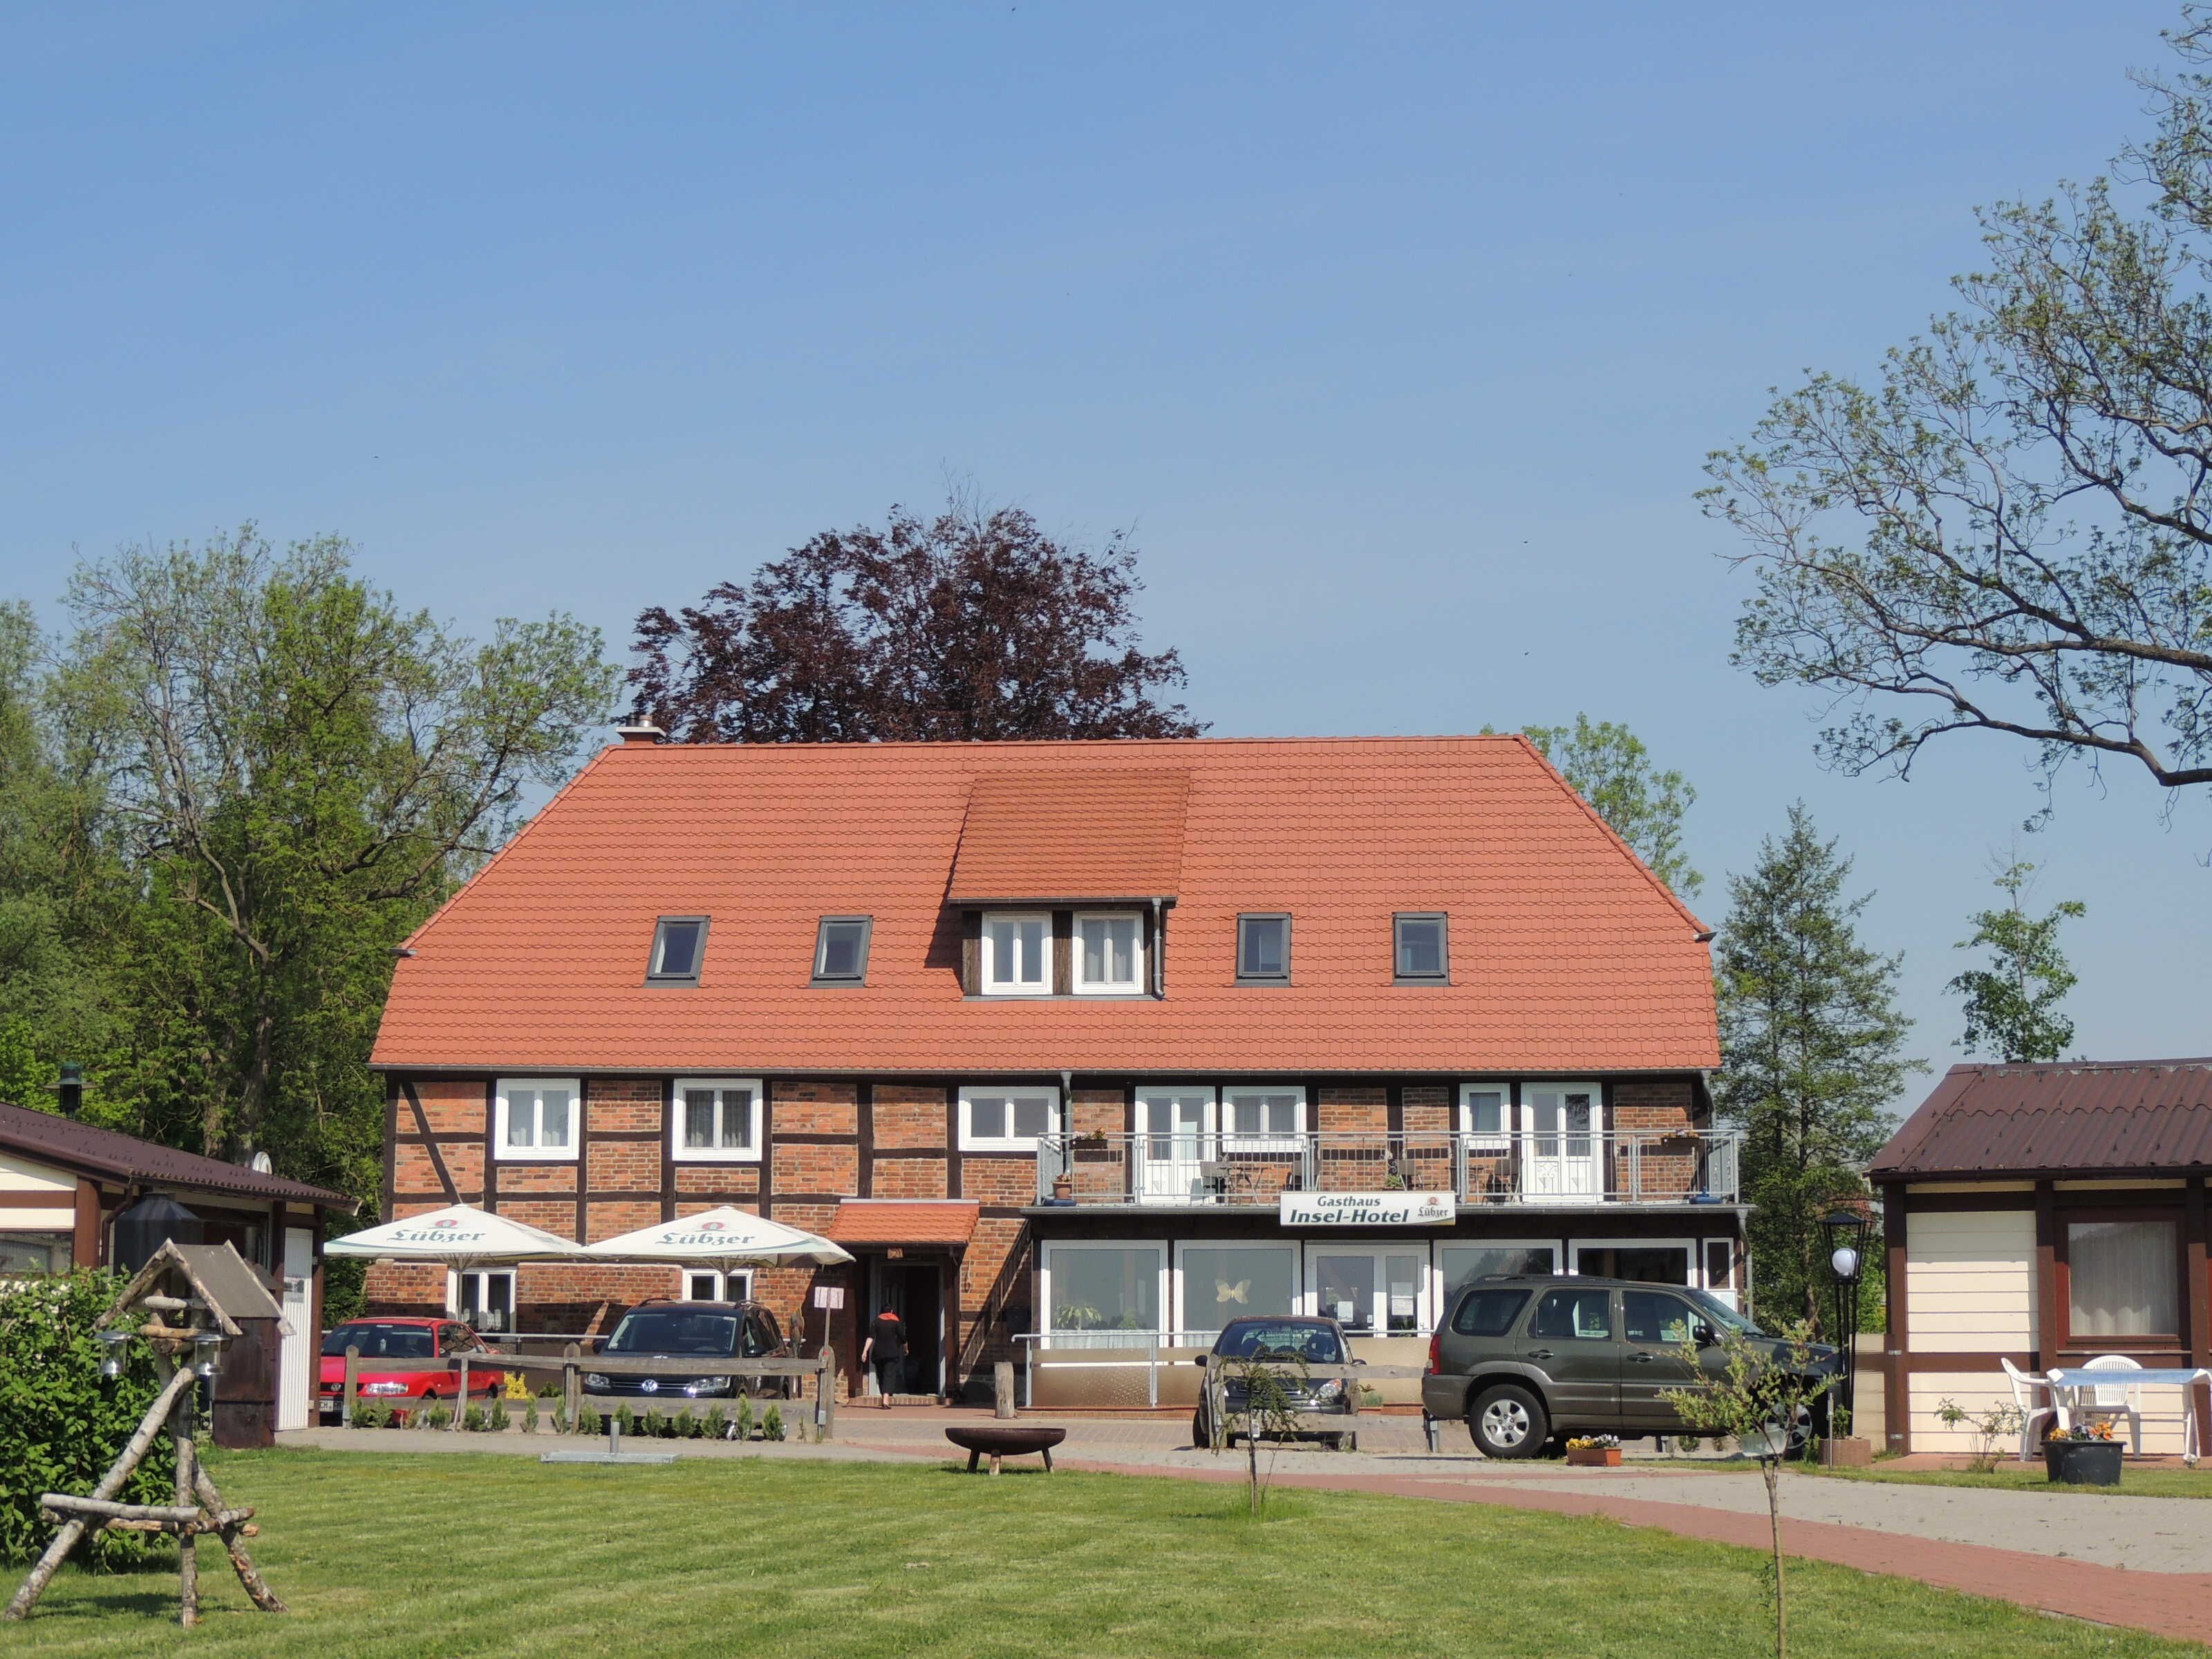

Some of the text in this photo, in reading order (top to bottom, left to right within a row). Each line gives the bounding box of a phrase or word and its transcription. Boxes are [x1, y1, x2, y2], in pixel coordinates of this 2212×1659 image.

[1318, 1196, 1380, 1207] Gasthaus
[1289, 1209, 1409, 1223] Insel-Hotel
[1418, 1206, 1449, 1218] Lübzer
[387, 1229, 486, 1242] Lübzer
[655, 1232, 756, 1246] Lübzer
